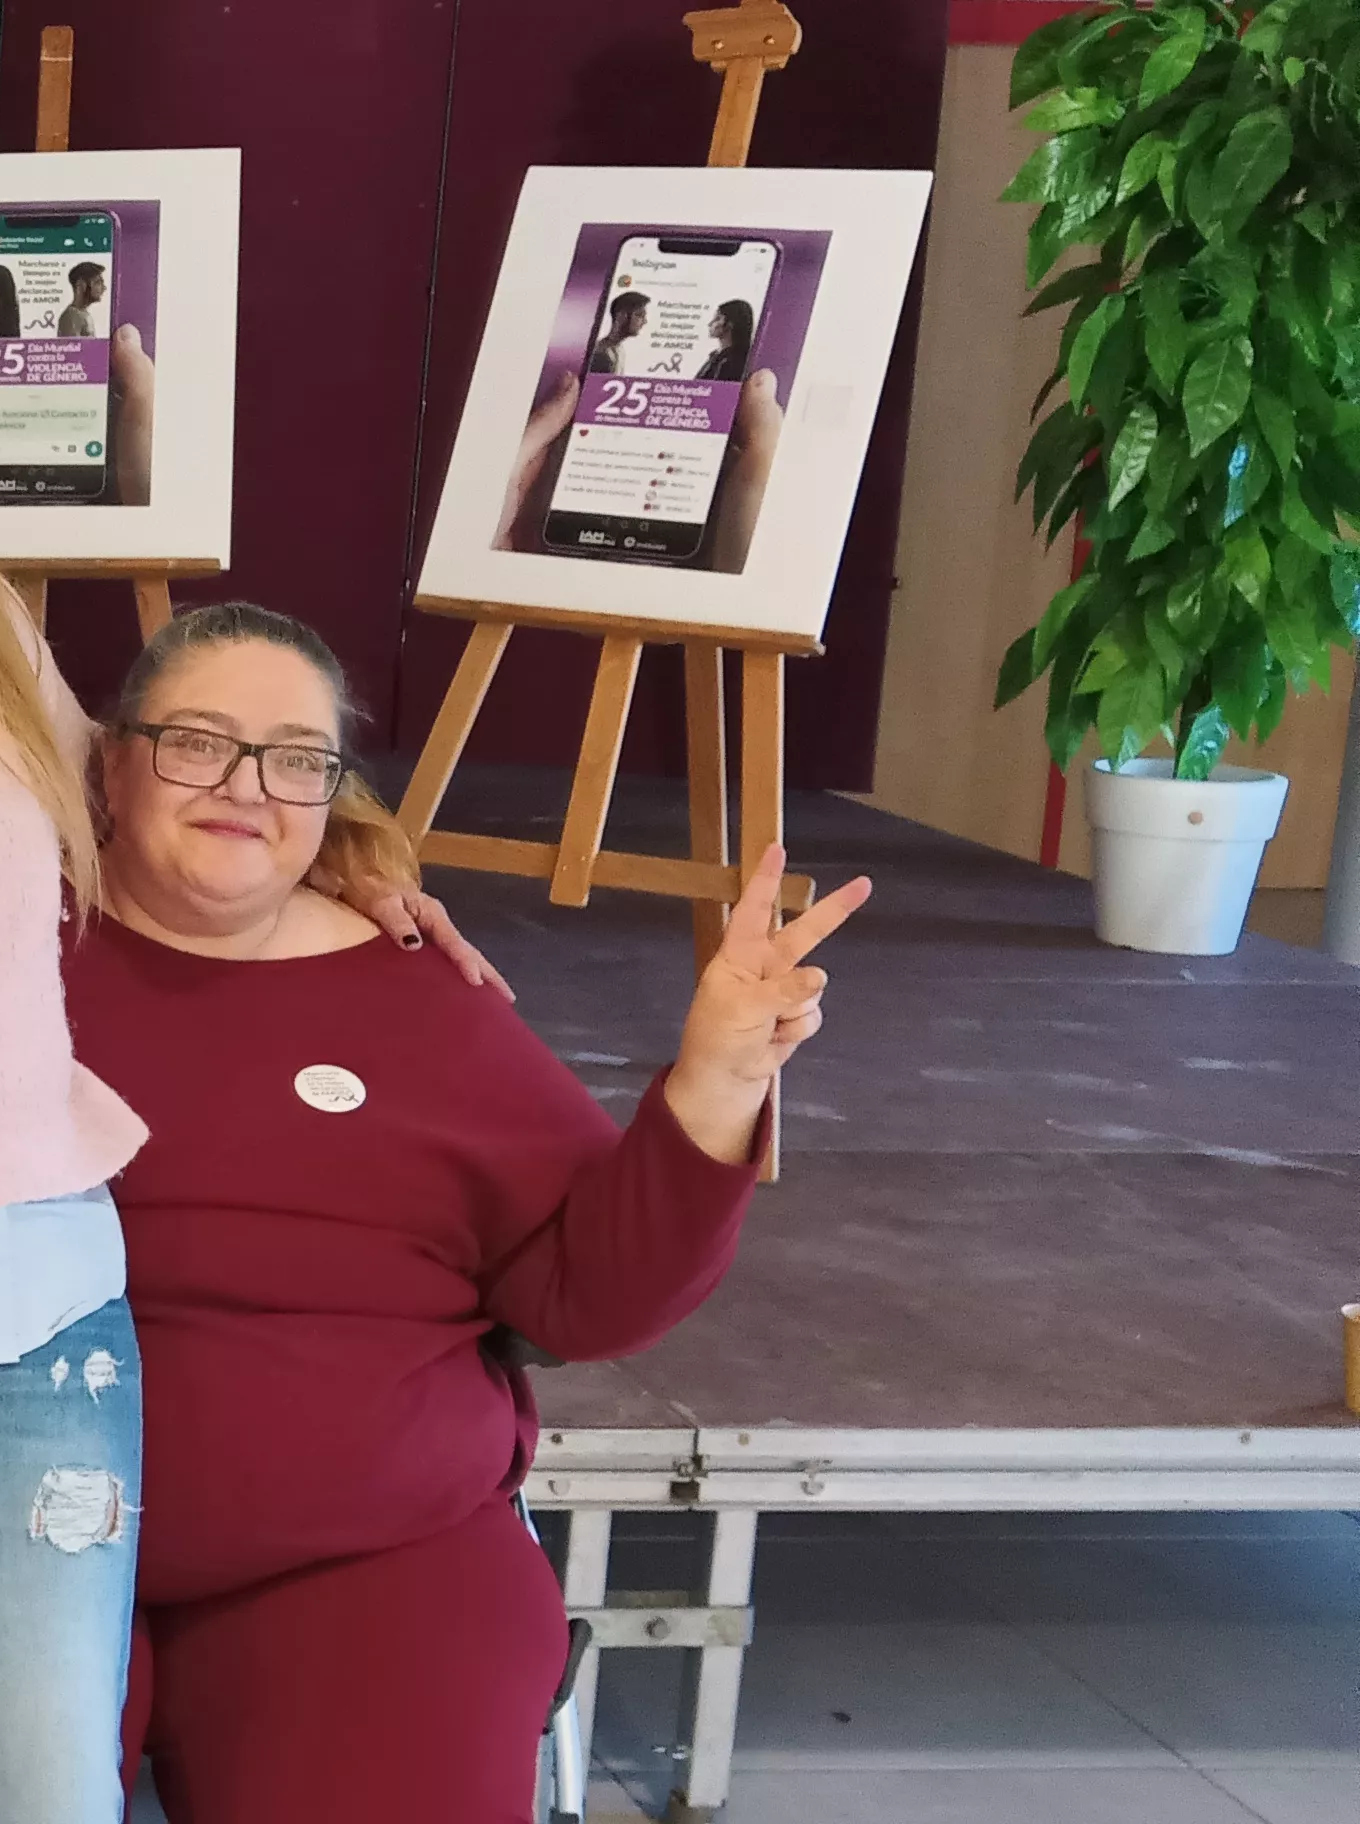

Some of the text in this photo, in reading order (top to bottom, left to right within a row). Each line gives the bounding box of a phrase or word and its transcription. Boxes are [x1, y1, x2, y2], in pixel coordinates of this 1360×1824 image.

[45, 343, 81, 352] Mundial
[27, 354, 65, 362] contra la
[27, 363, 84, 373] VIOLENCIA
[27, 373, 41, 382] DE
[43, 372, 87, 382] GÉNERO
[595, 380, 652, 416] 25
[649, 405, 709, 418] VIOLENCIA
[645, 415, 661, 426] DE
